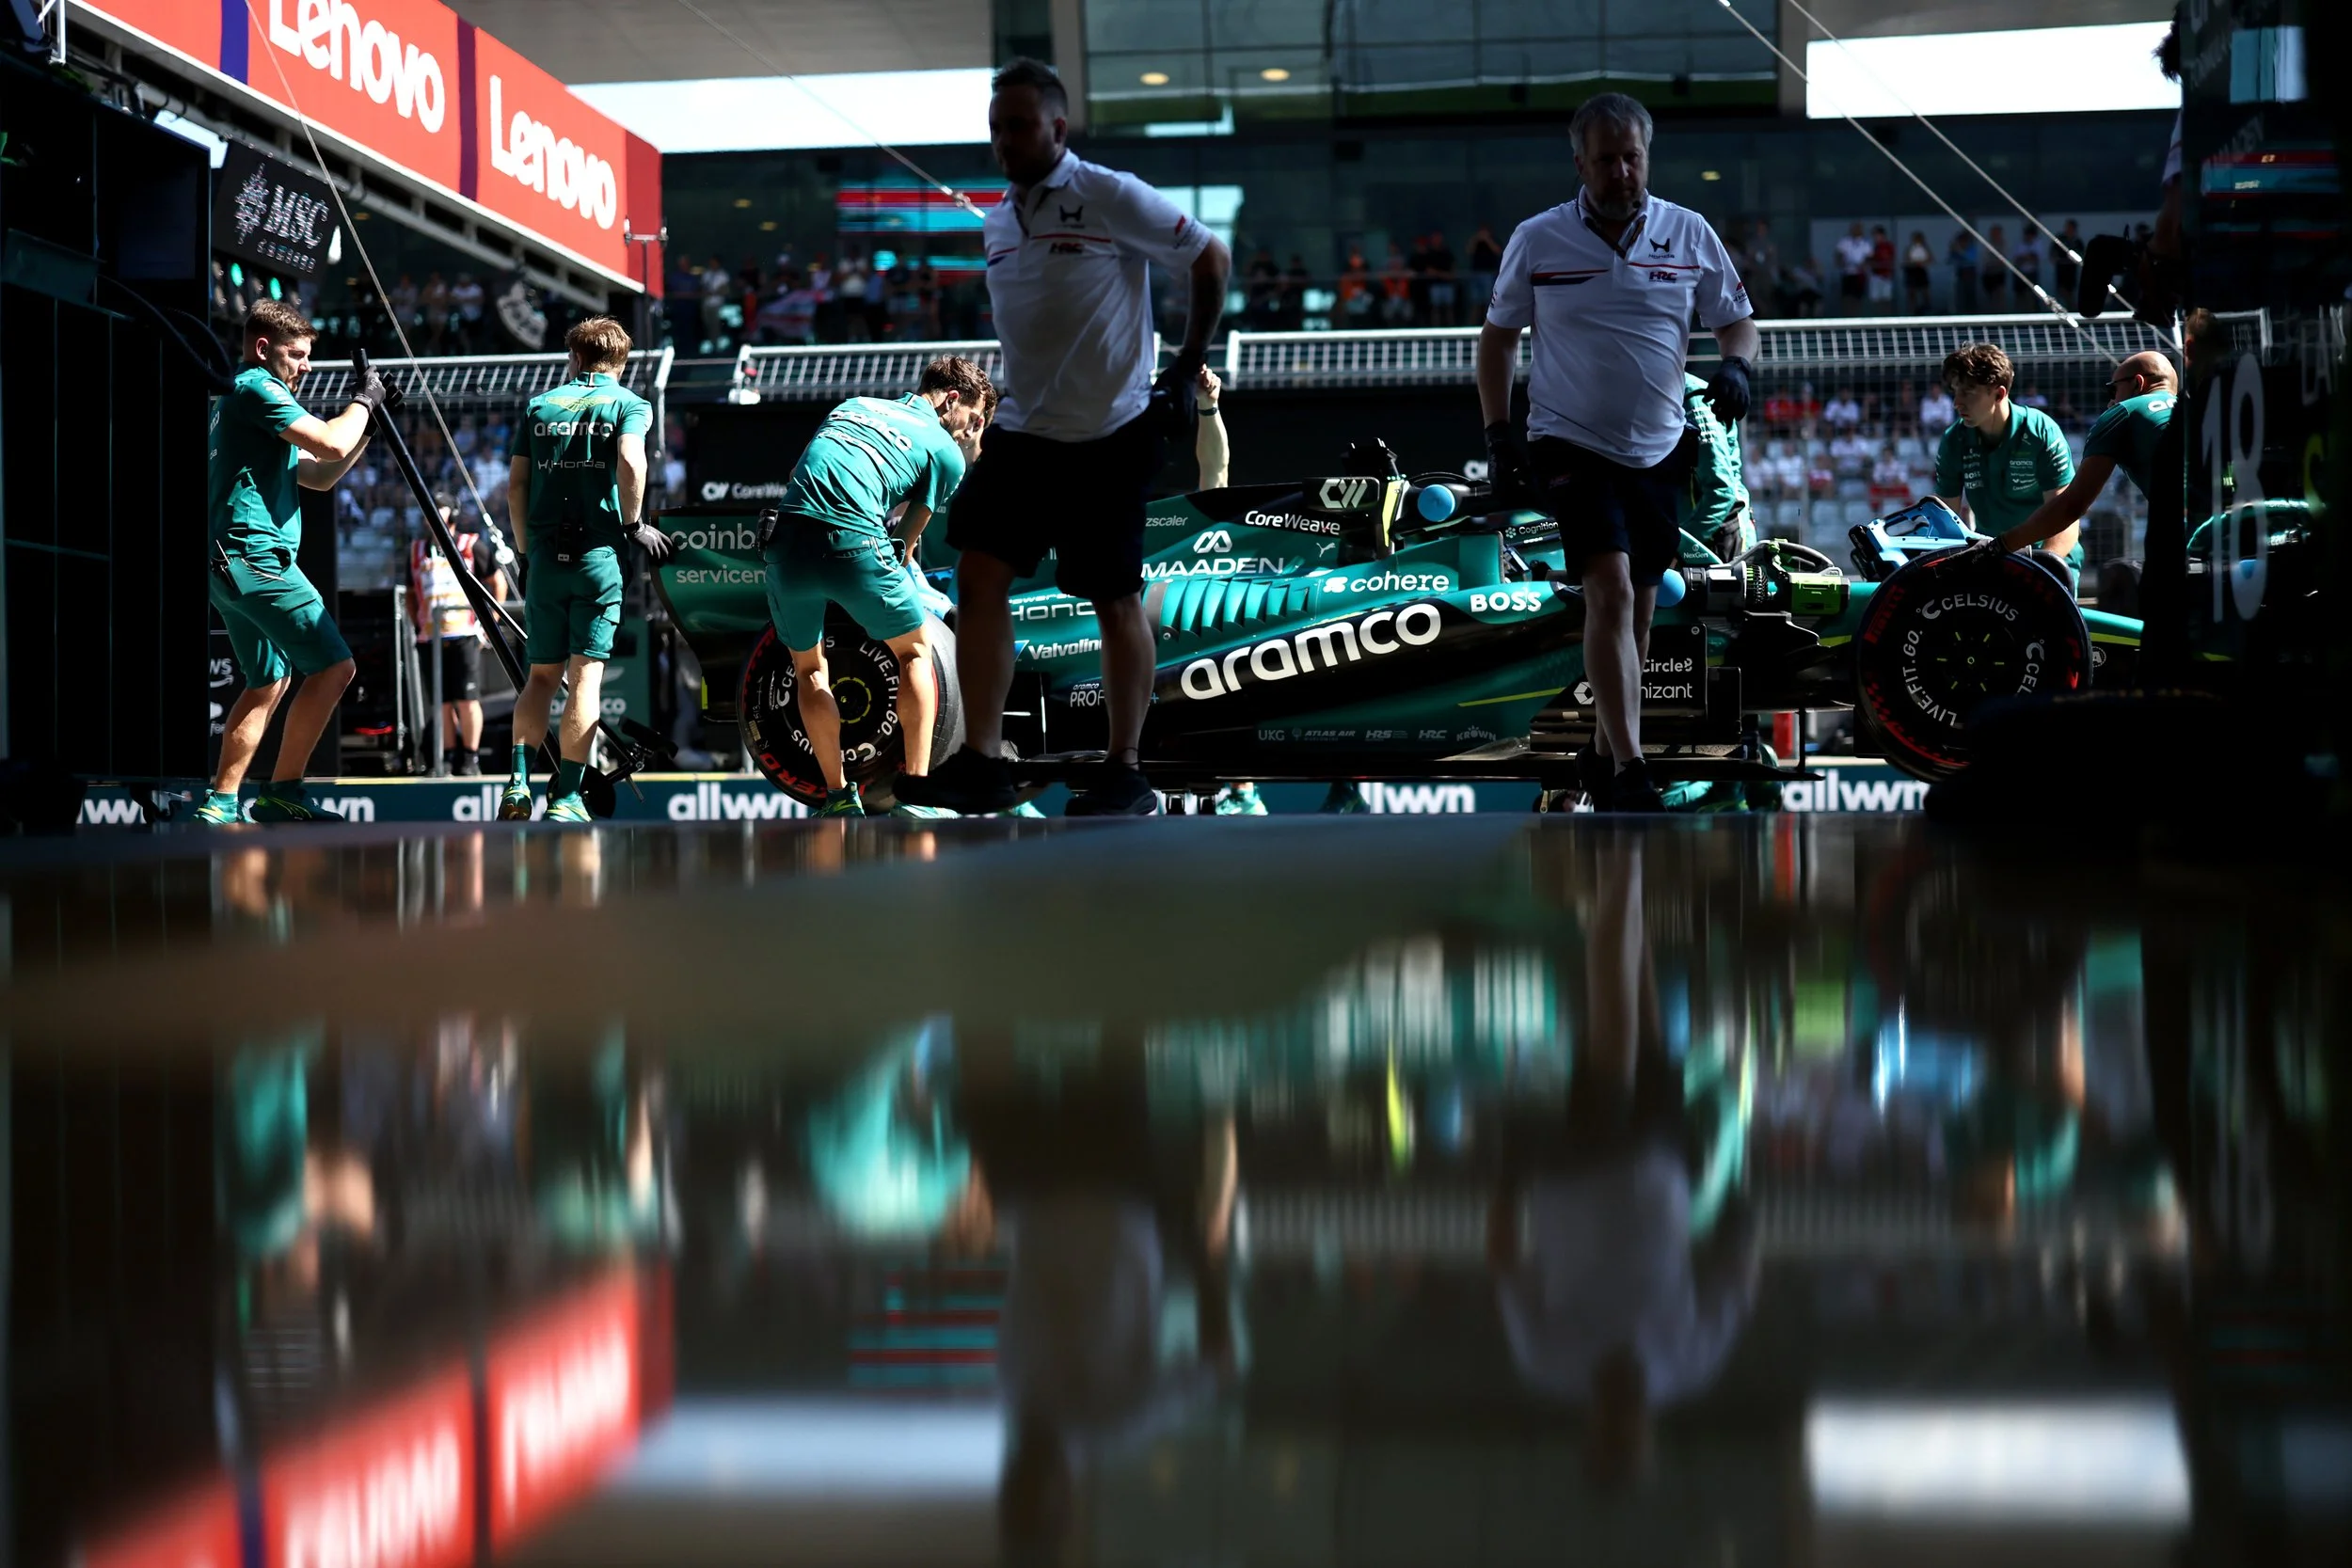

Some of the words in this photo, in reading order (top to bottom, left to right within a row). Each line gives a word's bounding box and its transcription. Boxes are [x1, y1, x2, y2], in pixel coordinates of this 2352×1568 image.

[489, 74, 617, 230] Lenovo
[1649, 271, 1677, 281] HRC
[533, 421, 614, 437] aramco
[2201, 353, 2268, 625] 18
[1145, 515, 1188, 528] zscaler
[1245, 510, 1341, 536] CoreWeave
[1518, 521, 1559, 534] Cognition
[1140, 557, 1285, 578] MAADEN
[1350, 572, 1450, 593] cohere
[1470, 592, 1542, 613] BOSS
[1941, 593, 2020, 622] CELSIUS
[1180, 603, 1442, 701] aramco
[1258, 729, 1285, 742] UKG
[1418, 730, 1448, 739] HRC
[1456, 728, 1497, 742] KROWN
